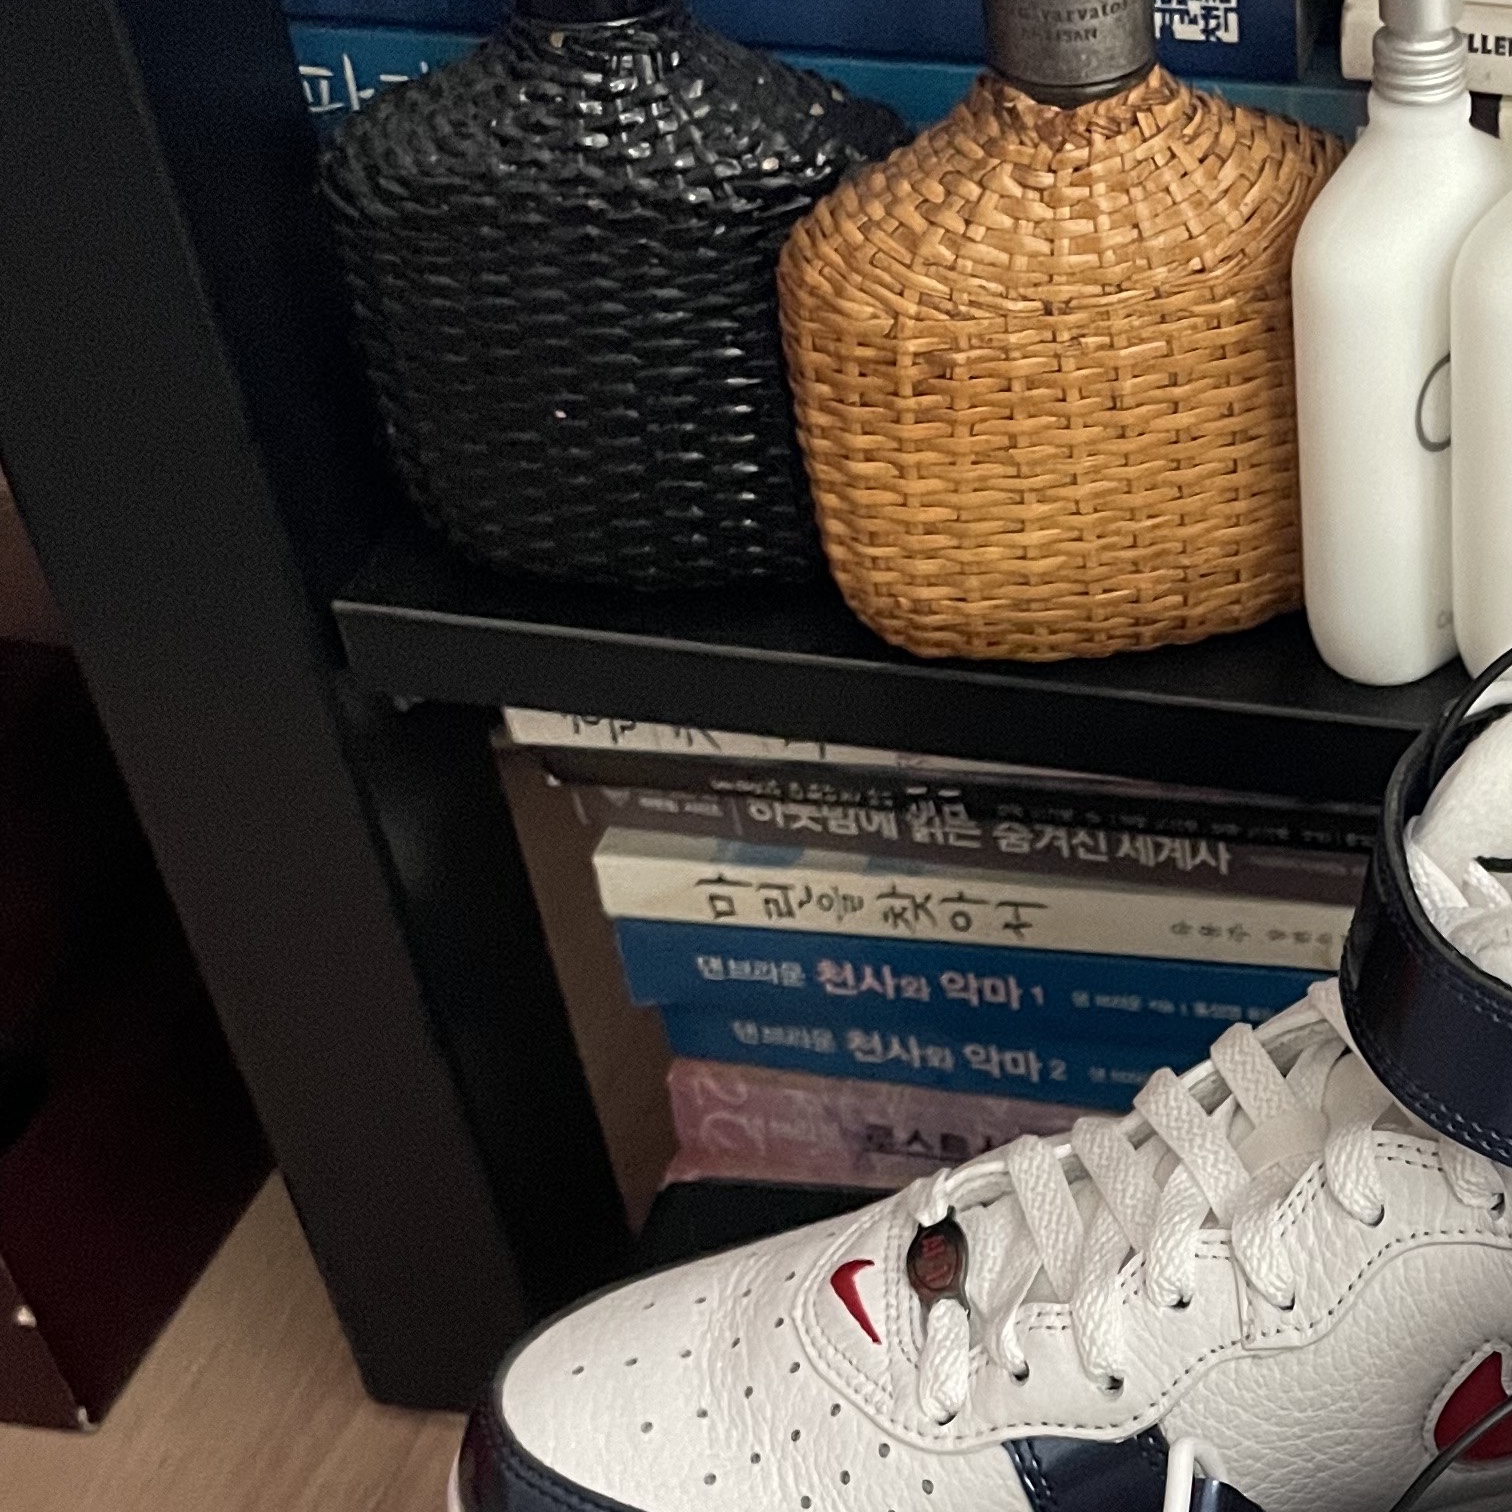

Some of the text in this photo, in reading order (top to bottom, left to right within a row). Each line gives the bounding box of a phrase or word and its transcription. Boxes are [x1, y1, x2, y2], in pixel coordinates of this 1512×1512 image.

[1115, 832, 1231, 875] 세계사
[816, 958, 930, 1001] 천사와
[940, 969, 1023, 1010] 악마
[847, 1027, 955, 1072] 천사와
[963, 1044, 1043, 1083] 악마
[1051, 1060, 1067, 1081] 2
